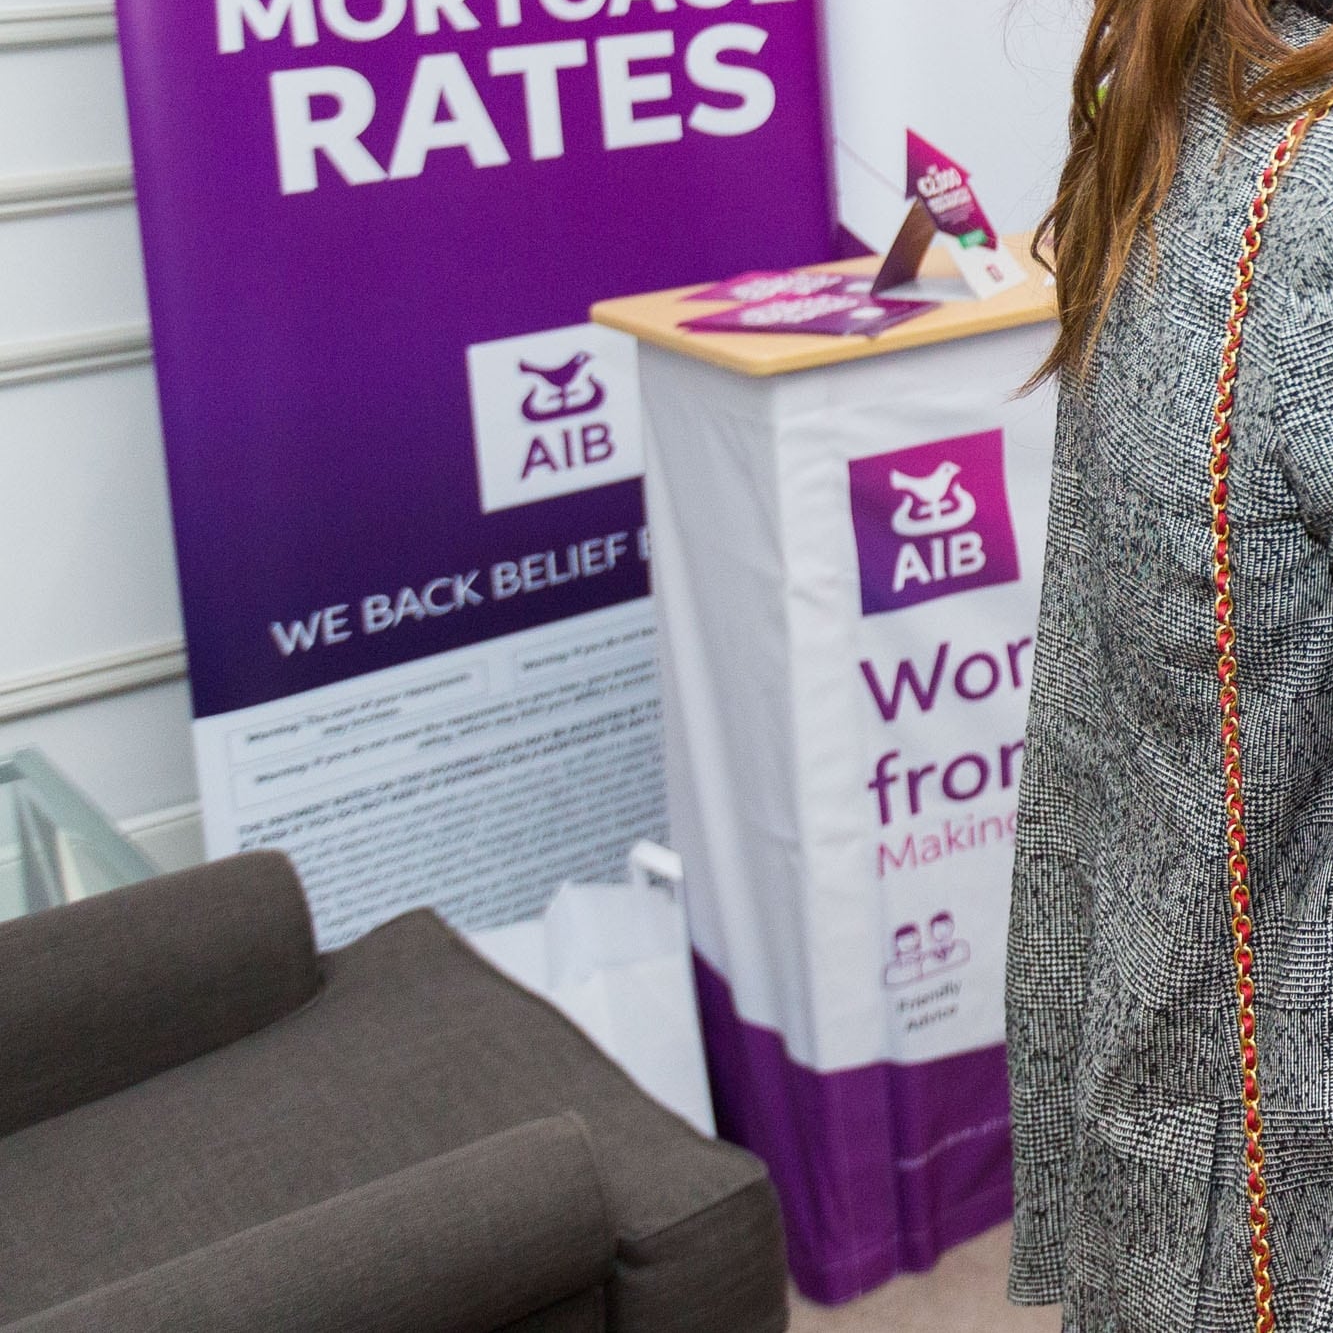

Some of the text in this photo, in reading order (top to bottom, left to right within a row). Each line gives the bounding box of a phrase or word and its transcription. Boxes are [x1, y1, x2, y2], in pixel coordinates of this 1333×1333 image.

[268, 22, 778, 196] RATES
[519, 423, 616, 481] AIB
[269, 603, 353, 657] WE
[360, 568, 485, 635] BACK
[491, 530, 629, 602] BELIEF
[890, 528, 987, 593] AIB
